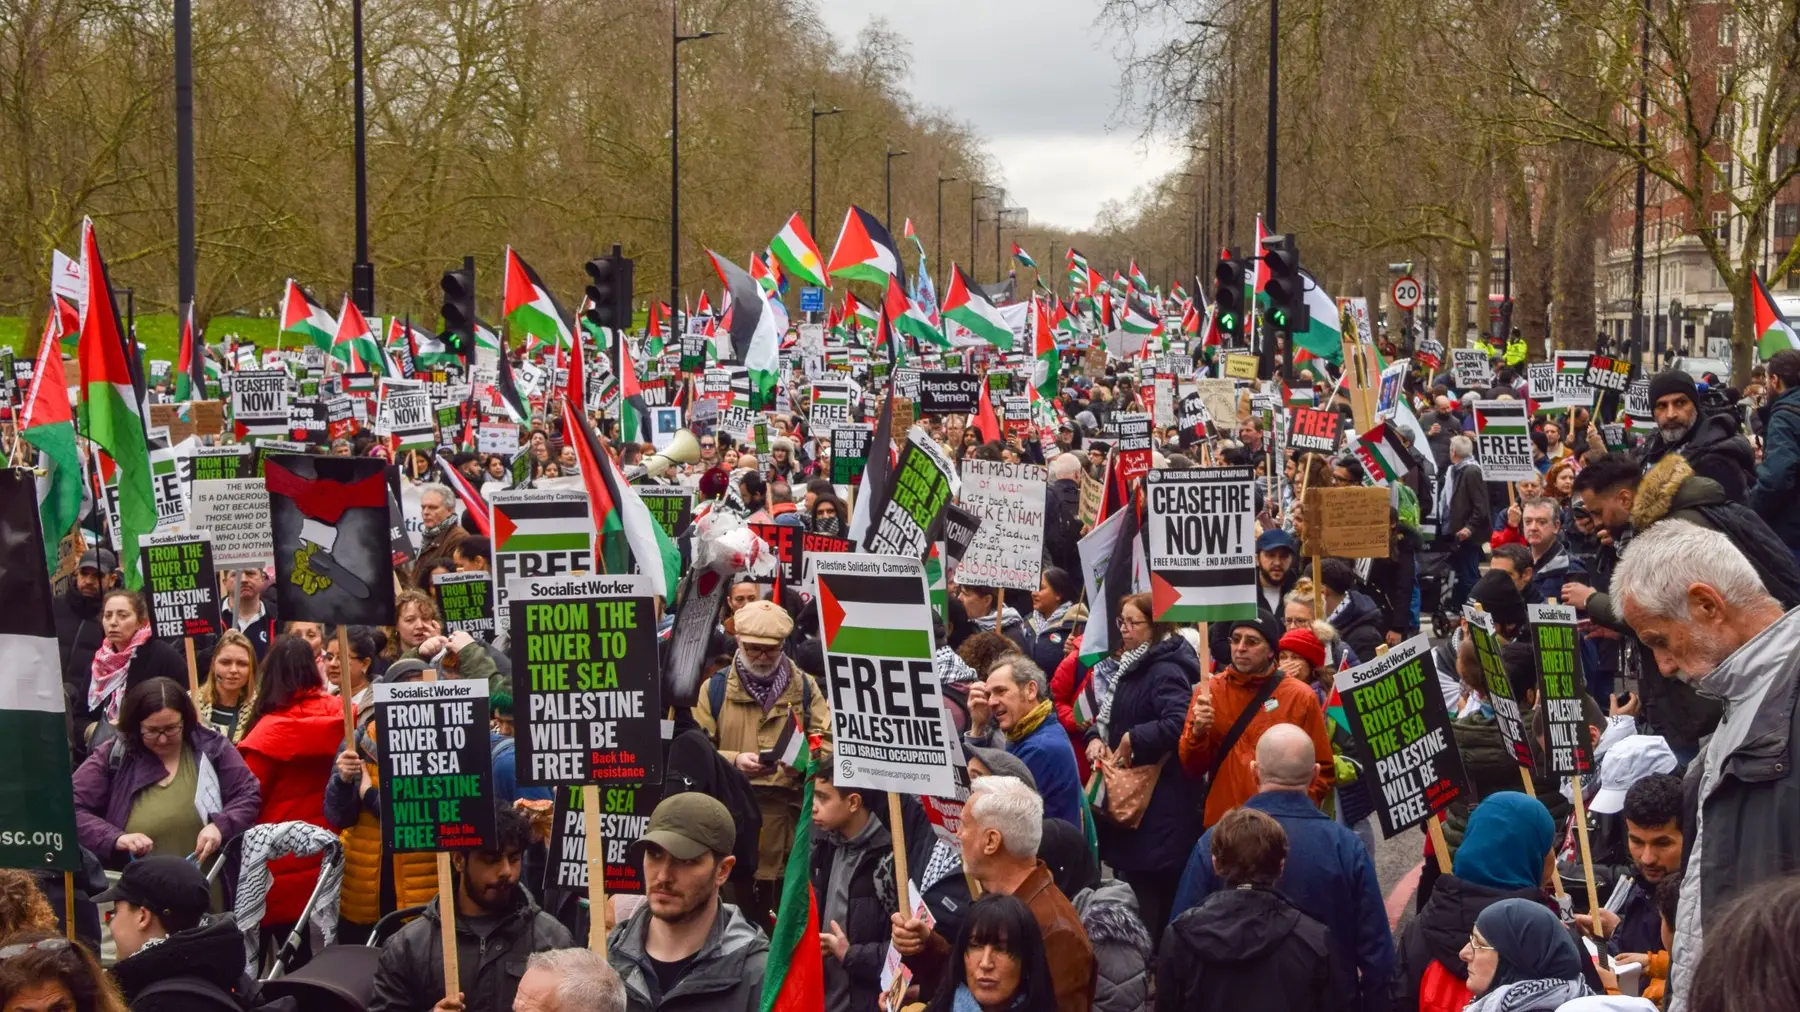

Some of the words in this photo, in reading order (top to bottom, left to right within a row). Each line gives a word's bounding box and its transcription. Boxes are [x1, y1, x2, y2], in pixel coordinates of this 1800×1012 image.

[1398, 287, 1416, 299] 20
[1592, 356, 1611, 367] END
[1613, 361, 1630, 373] THE
[235, 379, 284, 392] CEASEFIRE
[922, 381, 958, 391] Hands
[961, 381, 977, 391] Off
[1587, 367, 1628, 390] SIEGE
[389, 395, 427, 409] CEASEFIRE
[932, 392, 969, 402] Yemen
[289, 407, 313, 417] Free
[812, 405, 847, 419] FREE
[1121, 422, 1148, 434] FREEDOM
[1293, 409, 1338, 438] FREE
[835, 431, 855, 440] FROM
[856, 432, 867, 440] THE
[1121, 438, 1150, 450] PALESTINE
[1292, 435, 1334, 450] PALESTINE
[835, 440, 854, 449] RIVER
[856, 441, 864, 449] TO
[835, 449, 847, 457] THE
[849, 449, 860, 457] SEA
[1479, 436, 1529, 455] FREE
[196, 458, 221, 468] FROM
[224, 457, 240, 467] THE
[1482, 456, 1531, 464] PALESTINE
[225, 469, 236, 478] TO
[962, 460, 984, 475] THE
[989, 462, 1048, 481] MASTERS
[1190, 471, 1220, 479] SOLIDARITY
[1221, 470, 1248, 478] CAMPAIGN
[980, 478, 990, 488] of
[998, 483, 1023, 492] war
[493, 494, 522, 502] Palestine
[524, 494, 554, 502] Solidarity
[556, 492, 587, 502] Campaign
[667, 498, 683, 509] THE
[989, 495, 1008, 506] back
[1013, 500, 1024, 509] at
[1153, 485, 1251, 514] CEASEFIRE
[232, 502, 270, 510] BECAUSE
[668, 511, 678, 523] TO
[215, 523, 252, 531] BECAUSE
[878, 516, 903, 552] WILL
[995, 525, 1039, 542] Stadium
[149, 545, 179, 561] FROM
[182, 544, 204, 558] THE
[242, 541, 273, 549] NOTHIN
[150, 562, 181, 577] RIVER
[184, 560, 199, 574] TO
[817, 560, 846, 570] Palestine
[847, 561, 881, 574] Solidarity
[883, 563, 920, 575] Campaign
[1154, 558, 1168, 566] FREE
[1170, 558, 1200, 566] PALESTINE
[1206, 557, 1218, 566] END
[1220, 556, 1253, 565] APARTHEID
[151, 577, 172, 592] THE
[176, 575, 196, 590] SEA
[1001, 571, 1033, 582] MONEY
[153, 588, 211, 607] PALESTINE
[441, 584, 467, 596] FROM
[470, 582, 487, 593] THE
[531, 582, 587, 596] Socialist
[588, 583, 633, 594] Worker
[443, 597, 468, 608] RIVER
[472, 595, 484, 605] TO
[155, 606, 181, 621] WILL
[183, 605, 198, 619] BE
[445, 610, 463, 620] THE
[464, 607, 482, 618] SEA
[526, 604, 588, 632] FROM
[596, 602, 637, 629] THE
[157, 621, 183, 637] FREE
[447, 618, 494, 632] PALESTINE
[1537, 626, 1561, 648] FROM
[1562, 627, 1574, 648] THE
[528, 633, 590, 661] RIVER
[598, 632, 626, 659] TO
[1352, 661, 1392, 683] Socialist
[1389, 645, 1416, 667] Worker
[1541, 650, 1564, 673] RIVER
[1564, 652, 1573, 673] TO
[528, 664, 569, 691] THE
[577, 662, 618, 690] SEA
[390, 687, 433, 698] Socialist
[434, 685, 471, 697] Worker
[828, 655, 940, 718] FREE
[1353, 676, 1399, 713] FROM
[1398, 659, 1425, 690] THE
[1544, 675, 1559, 697] THE
[1561, 675, 1574, 697] SEA
[387, 704, 434, 727] FROM
[440, 702, 474, 724] THE
[530, 691, 644, 721] PALESTINE
[1360, 702, 1406, 736] RIVER
[1405, 688, 1424, 715] TO
[1547, 700, 1584, 721] PALESTINE
[530, 722, 583, 750] WILL
[590, 721, 618, 749] BE
[835, 713, 944, 746] PALESTINE
[1368, 731, 1400, 760] THE
[1400, 715, 1426, 743] SEA
[1550, 724, 1570, 746] WILL
[1571, 725, 1579, 745] BE
[388, 728, 438, 751] RIVER
[443, 727, 466, 749] TO
[592, 753, 616, 763] Back
[620, 751, 635, 763] the
[840, 743, 856, 755] END
[858, 745, 887, 758] ISRAELI
[889, 748, 945, 765] OCCUPATION
[1375, 727, 1448, 784] PALESTINE
[1553, 749, 1574, 771] FREE
[389, 753, 422, 776] THE
[427, 751, 460, 775] SEA
[532, 752, 584, 780] FREE
[593, 766, 644, 778] resistance
[858, 766, 930, 781] www.palestinecampaign.org
[392, 775, 481, 799] PALESTINE
[1381, 775, 1421, 806] WILL
[1419, 759, 1438, 788] BE
[606, 789, 634, 813] SEA
[393, 800, 433, 824] WILL
[439, 800, 460, 822] BE
[1389, 793, 1428, 830] FREE
[0, 832, 62, 850] sc.org
[394, 826, 435, 848] FREE
[607, 841, 627, 863] BE
